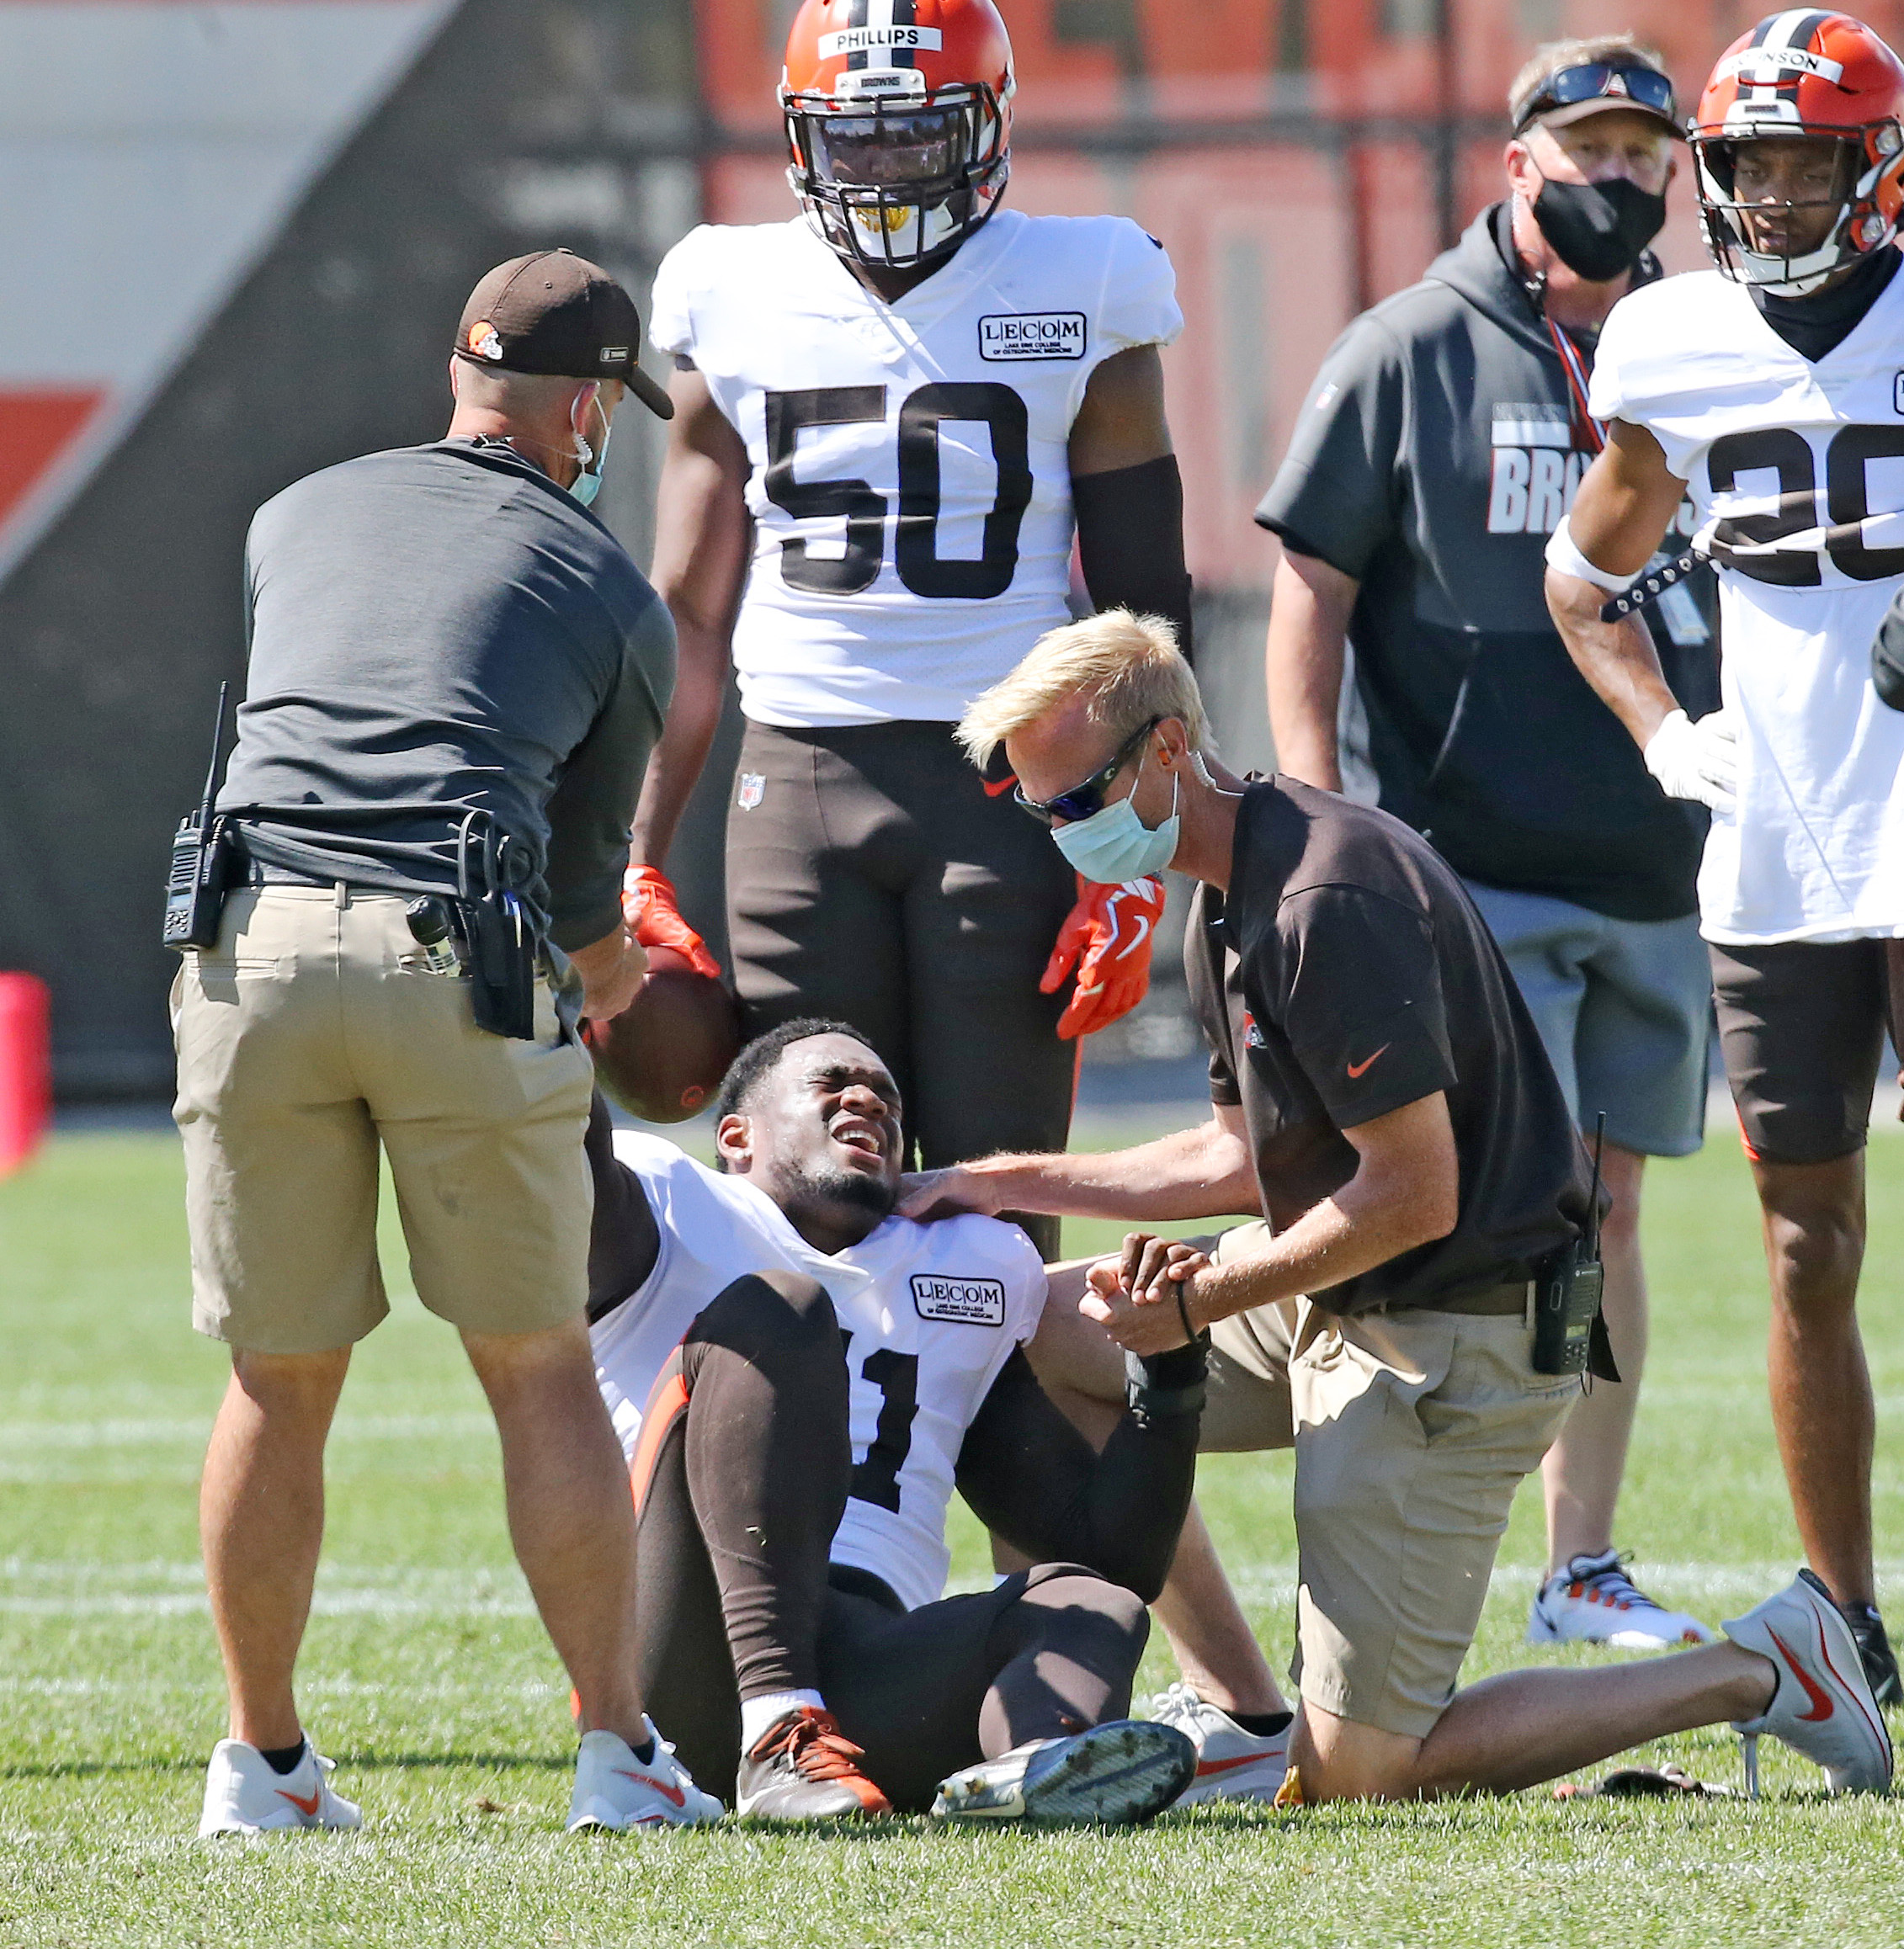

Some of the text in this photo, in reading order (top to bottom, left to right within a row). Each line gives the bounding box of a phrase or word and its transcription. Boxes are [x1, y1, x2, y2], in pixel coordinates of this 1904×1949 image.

[838, 29, 918, 50] PHILLIPS
[860, 76, 901, 88] BROWNS
[764, 381, 1034, 598] 50
[1707, 423, 1904, 587] 20
[840, 1328, 919, 1515] 1
